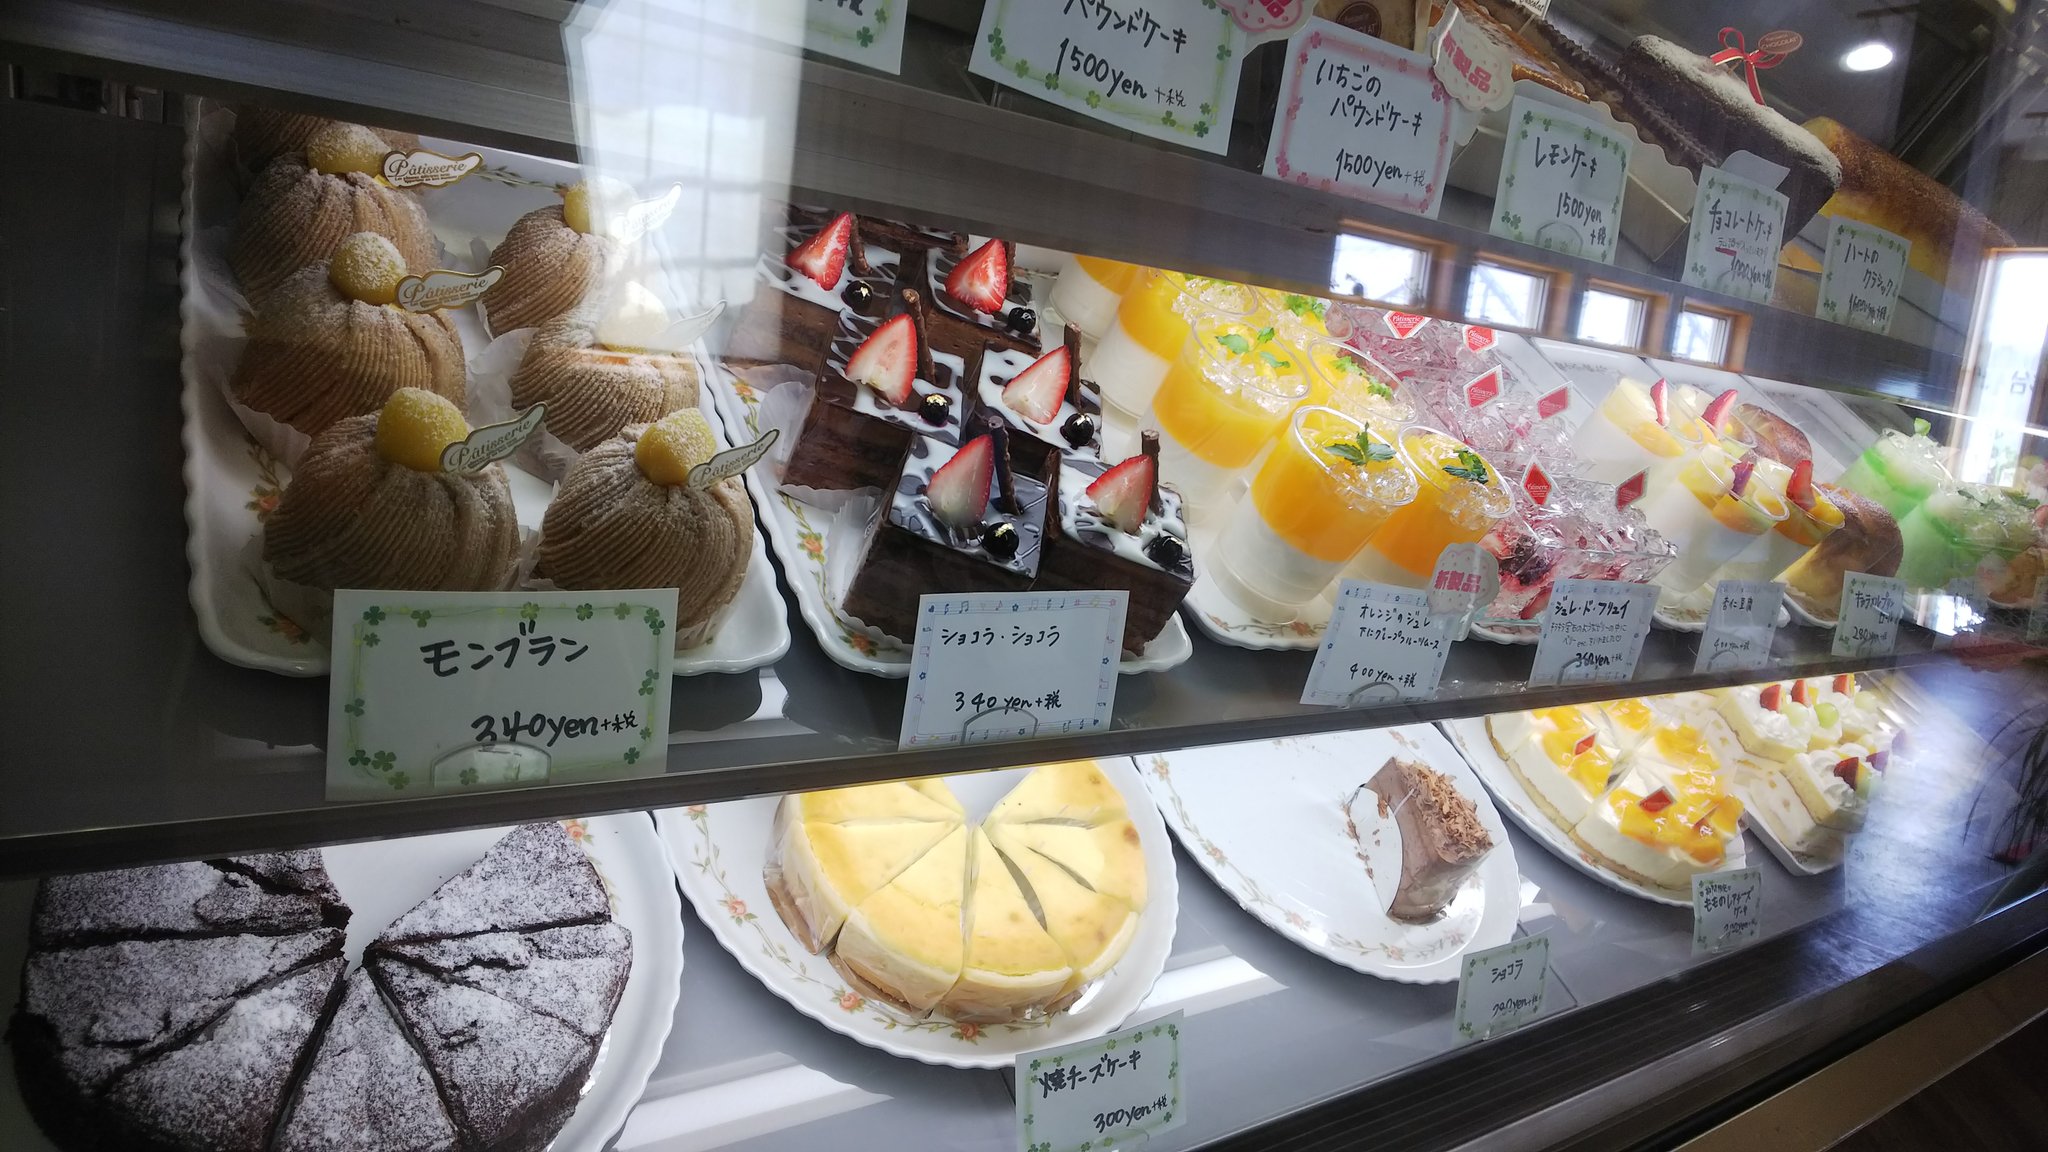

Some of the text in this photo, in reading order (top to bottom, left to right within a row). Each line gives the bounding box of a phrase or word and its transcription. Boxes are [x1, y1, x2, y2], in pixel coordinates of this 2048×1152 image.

[1316, 59, 1381, 97] いちごの
[1330, 95, 1423, 136] パウンドケーキ
[389, 159, 466, 177] Pâtisserie
[1535, 137, 1597, 178] レモンケーキ
[1557, 192, 1601, 226] 1500yen
[1709, 199, 1772, 241] チョコレートケーキ
[1844, 243, 1879, 264] ハートの
[1434, 569, 1482, 593] 新製品
[1359, 603, 1431, 629] オレンジのジュレ
[420, 619, 589, 678] モンブラン
[941, 625, 1061, 647] ショコラ・ショコラ
[1491, 959, 1523, 984] ショコラ
[1038, 1050, 1141, 1099] 焼チーズケーキ
